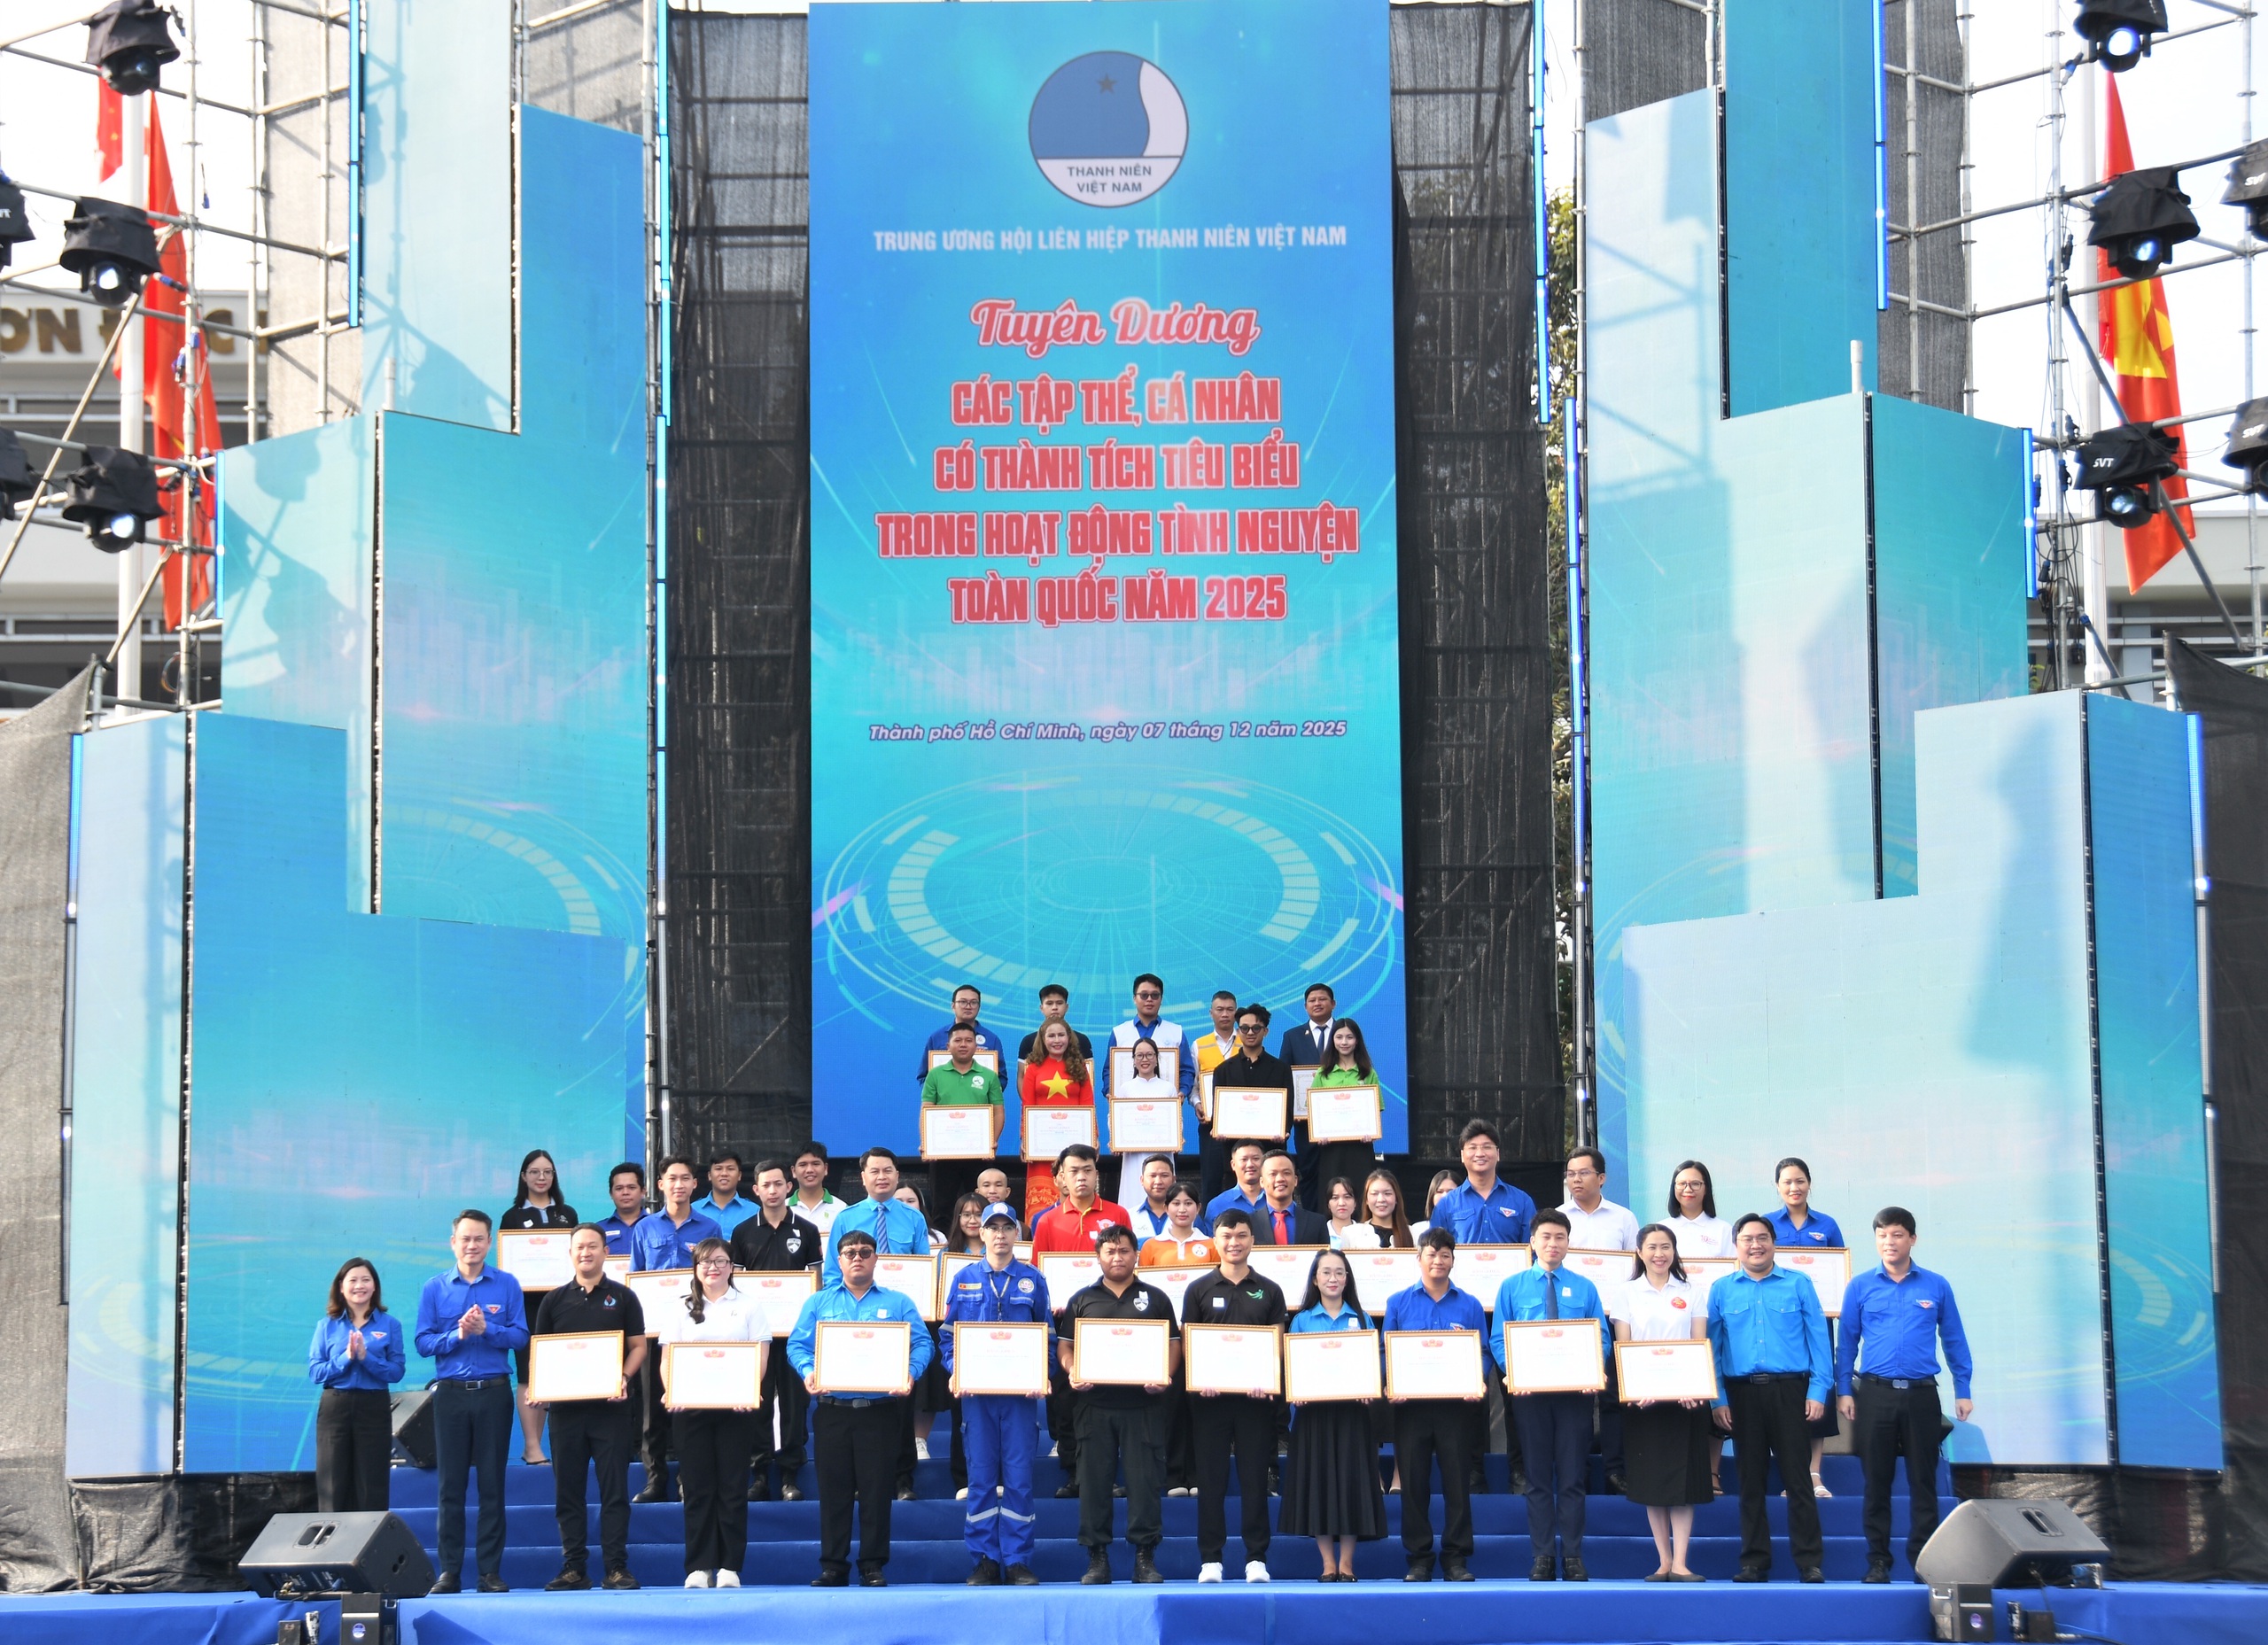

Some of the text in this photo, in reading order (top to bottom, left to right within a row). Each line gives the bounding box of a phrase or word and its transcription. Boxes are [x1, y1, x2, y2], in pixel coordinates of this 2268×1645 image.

[1067, 163, 1152, 177] THANH NIÊN
[1076, 180, 1143, 194] VIỆT NAM
[874, 222, 1348, 255] TRUNG ƯƠNG HỘI LIÊN HIỆP THANH NIÊN VIỆT NAM
[971, 297, 1262, 360] Tuyên Dương
[951, 364, 1281, 435] CÁC TẬP THỂ, CÁ NHÂN
[933, 428, 1300, 492] CÓ THÀNH TÍCH TIÊU BIỂU
[2092, 457, 2115, 469] SVT
[875, 499, 1360, 567] TRONG HOẠT ĐỘNG TÌNH NGUYỆN
[948, 564, 1287, 628] TOÀN QUỐC NĂM 2025
[869, 718, 1348, 743] Thành phố Hồ Chí Minh, ngày 07 tháng 12 năm 2025
